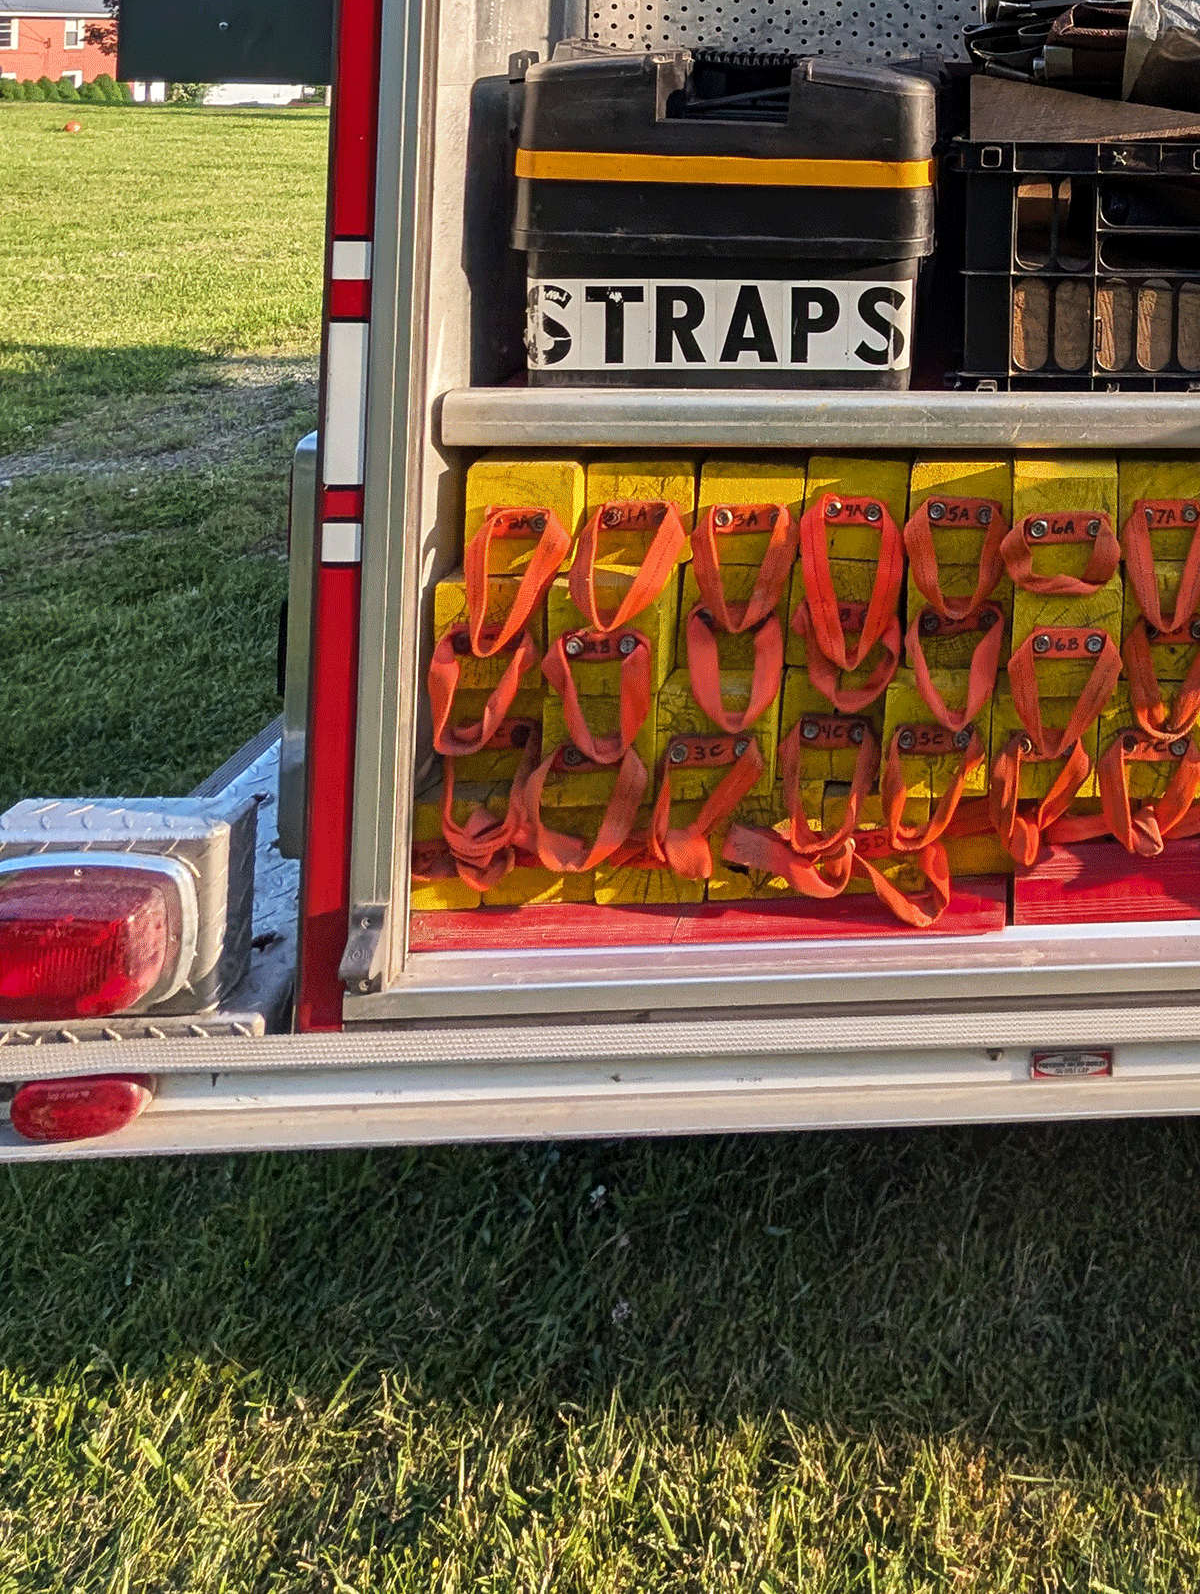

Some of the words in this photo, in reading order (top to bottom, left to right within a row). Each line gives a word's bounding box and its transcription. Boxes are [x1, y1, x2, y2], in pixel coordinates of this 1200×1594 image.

[527, 284, 907, 366] STRAPS
[734, 510, 758, 527] 3A
[946, 507, 970, 524] 5A
[1156, 508, 1177, 525] 7A
[1051, 519, 1076, 536] 6A
[1055, 637, 1078, 653] 6B
[919, 731, 942, 746] 5C
[693, 744, 721, 762] 3C
